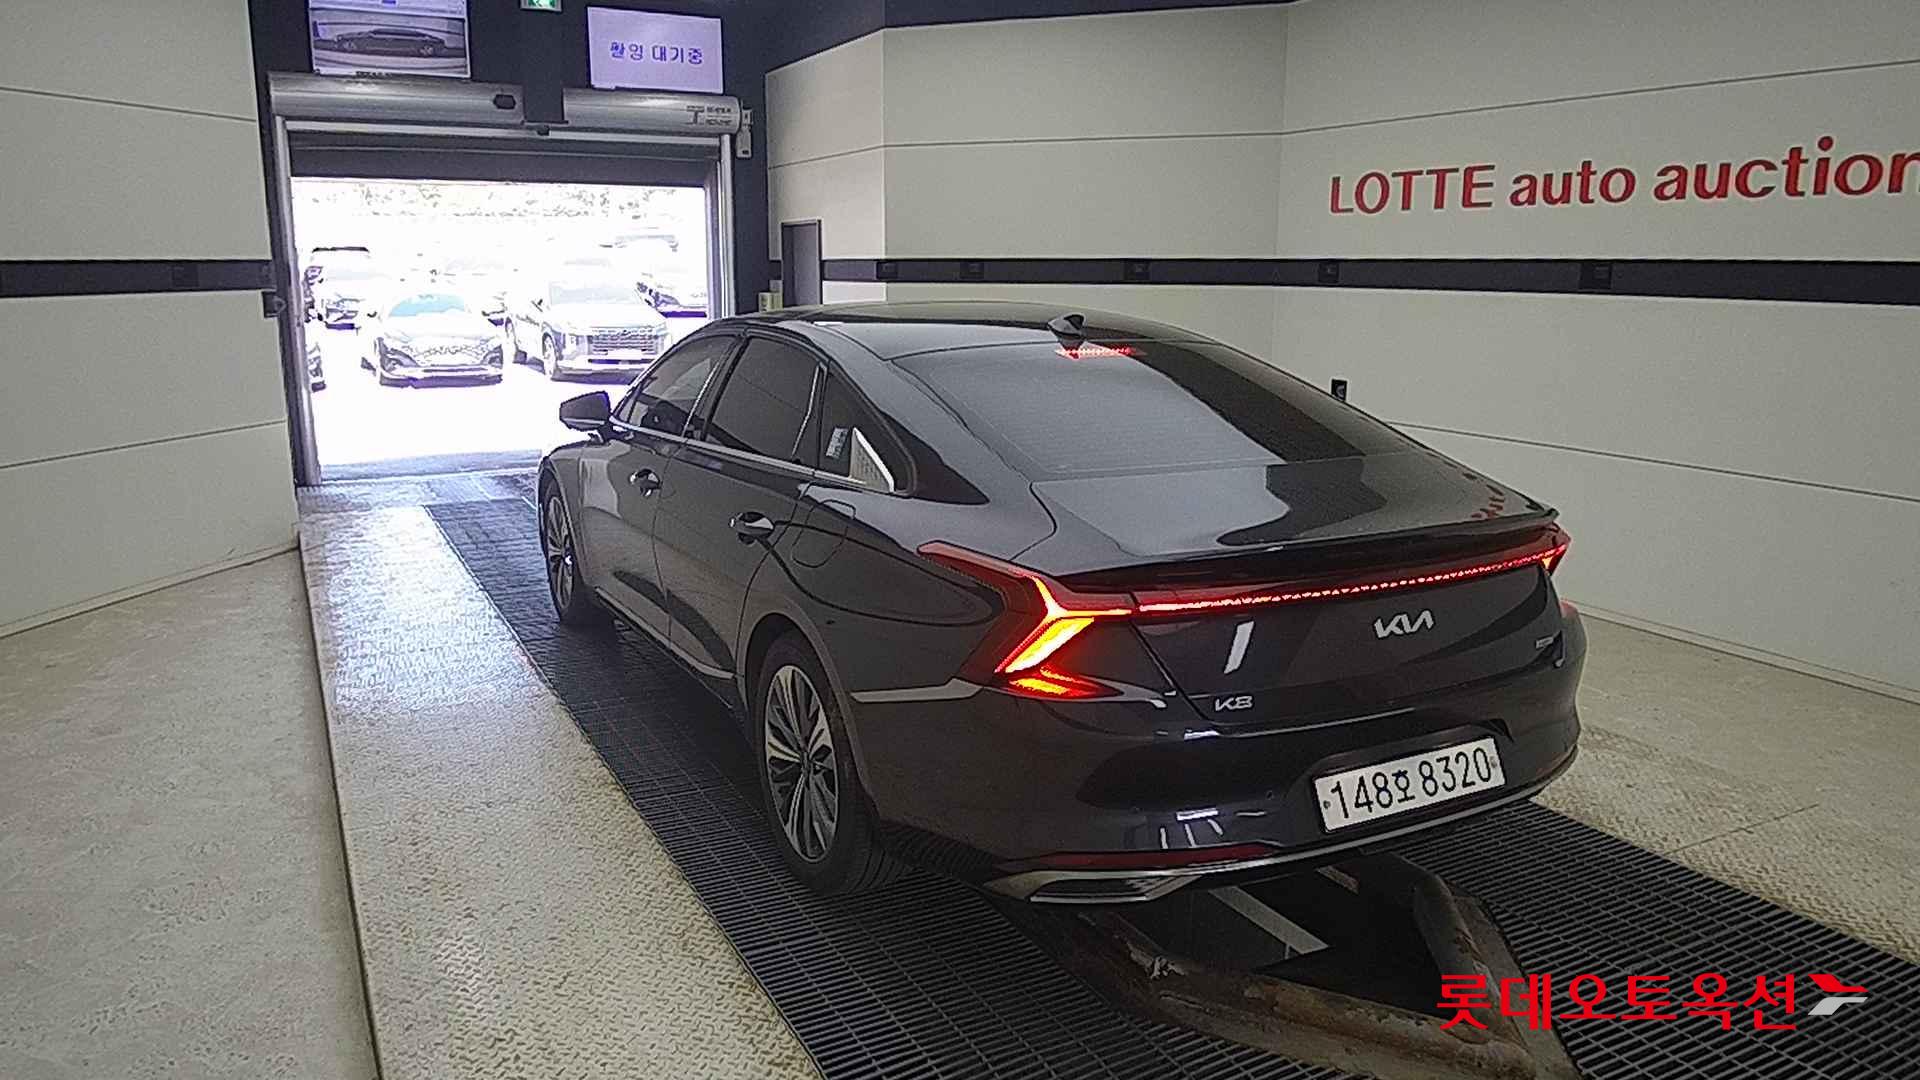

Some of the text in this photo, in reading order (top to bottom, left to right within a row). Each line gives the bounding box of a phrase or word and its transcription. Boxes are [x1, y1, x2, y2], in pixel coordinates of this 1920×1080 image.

[652, 45, 703, 65] 대기중
[1330, 136, 1920, 214] LOTTE auto auction
[1374, 608, 1435, 639] KIA
[1214, 695, 1254, 712] K8
[1331, 747, 1492, 820] 148호 8320
